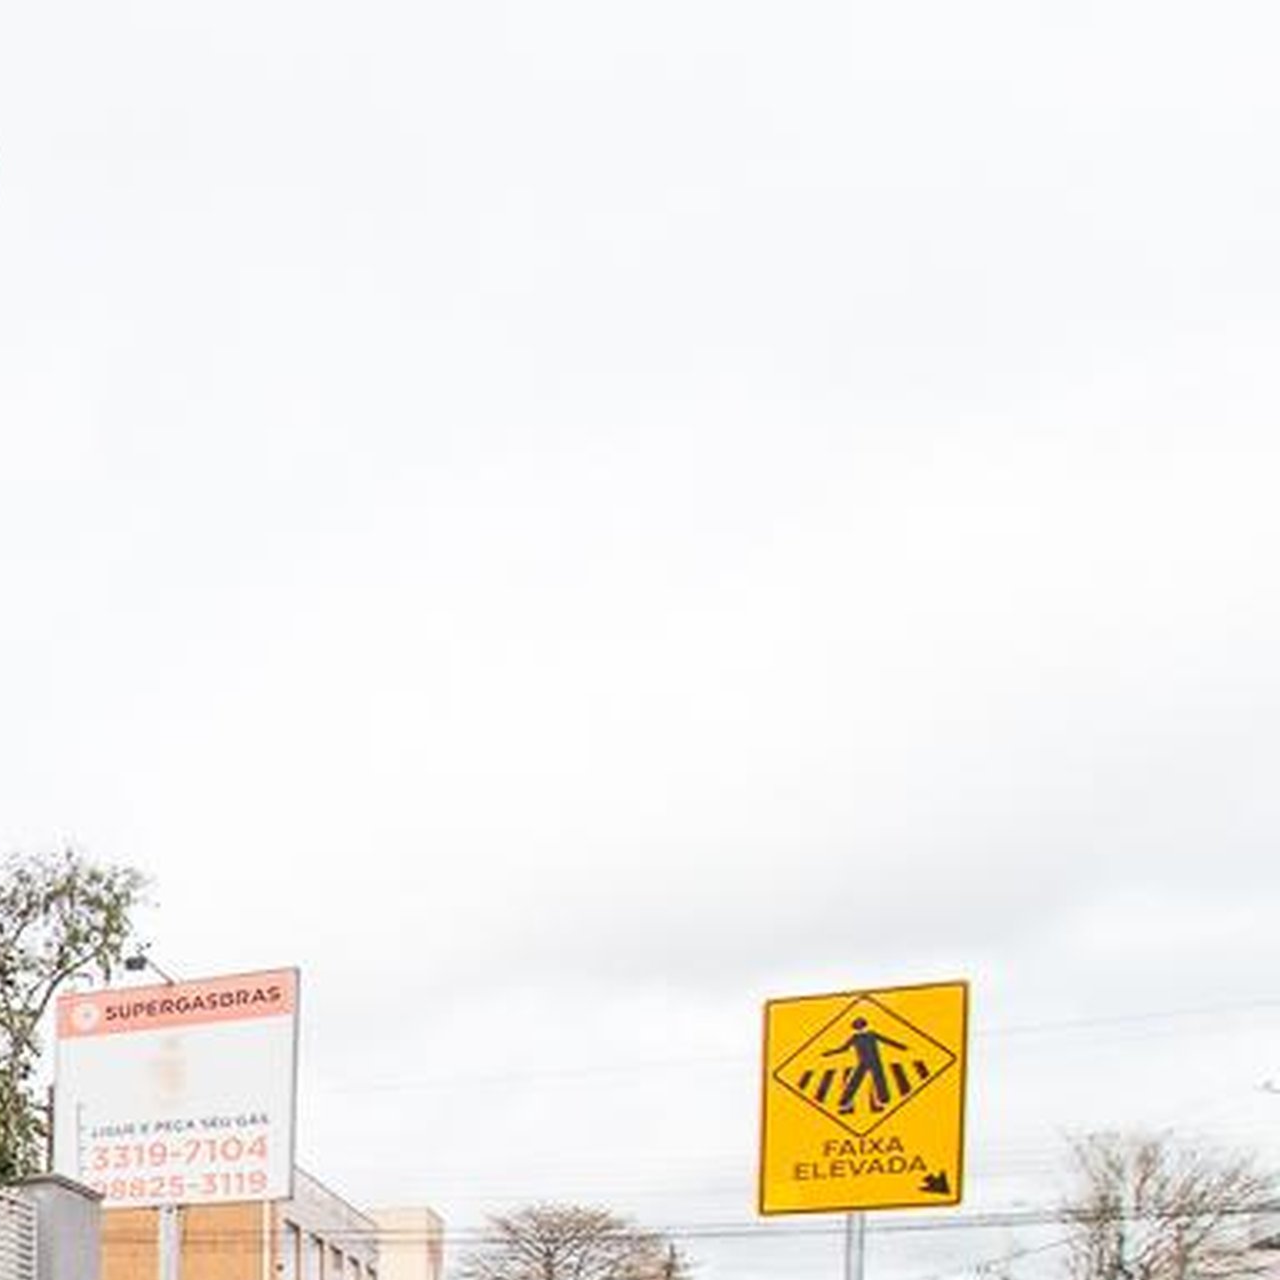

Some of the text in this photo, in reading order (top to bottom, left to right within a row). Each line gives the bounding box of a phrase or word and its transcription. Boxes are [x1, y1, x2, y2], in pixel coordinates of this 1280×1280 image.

[92, 1135, 268, 1171] 3319-7104
[822, 1135, 905, 1157] FAIXA
[793, 1155, 928, 1182] ELEVADA
